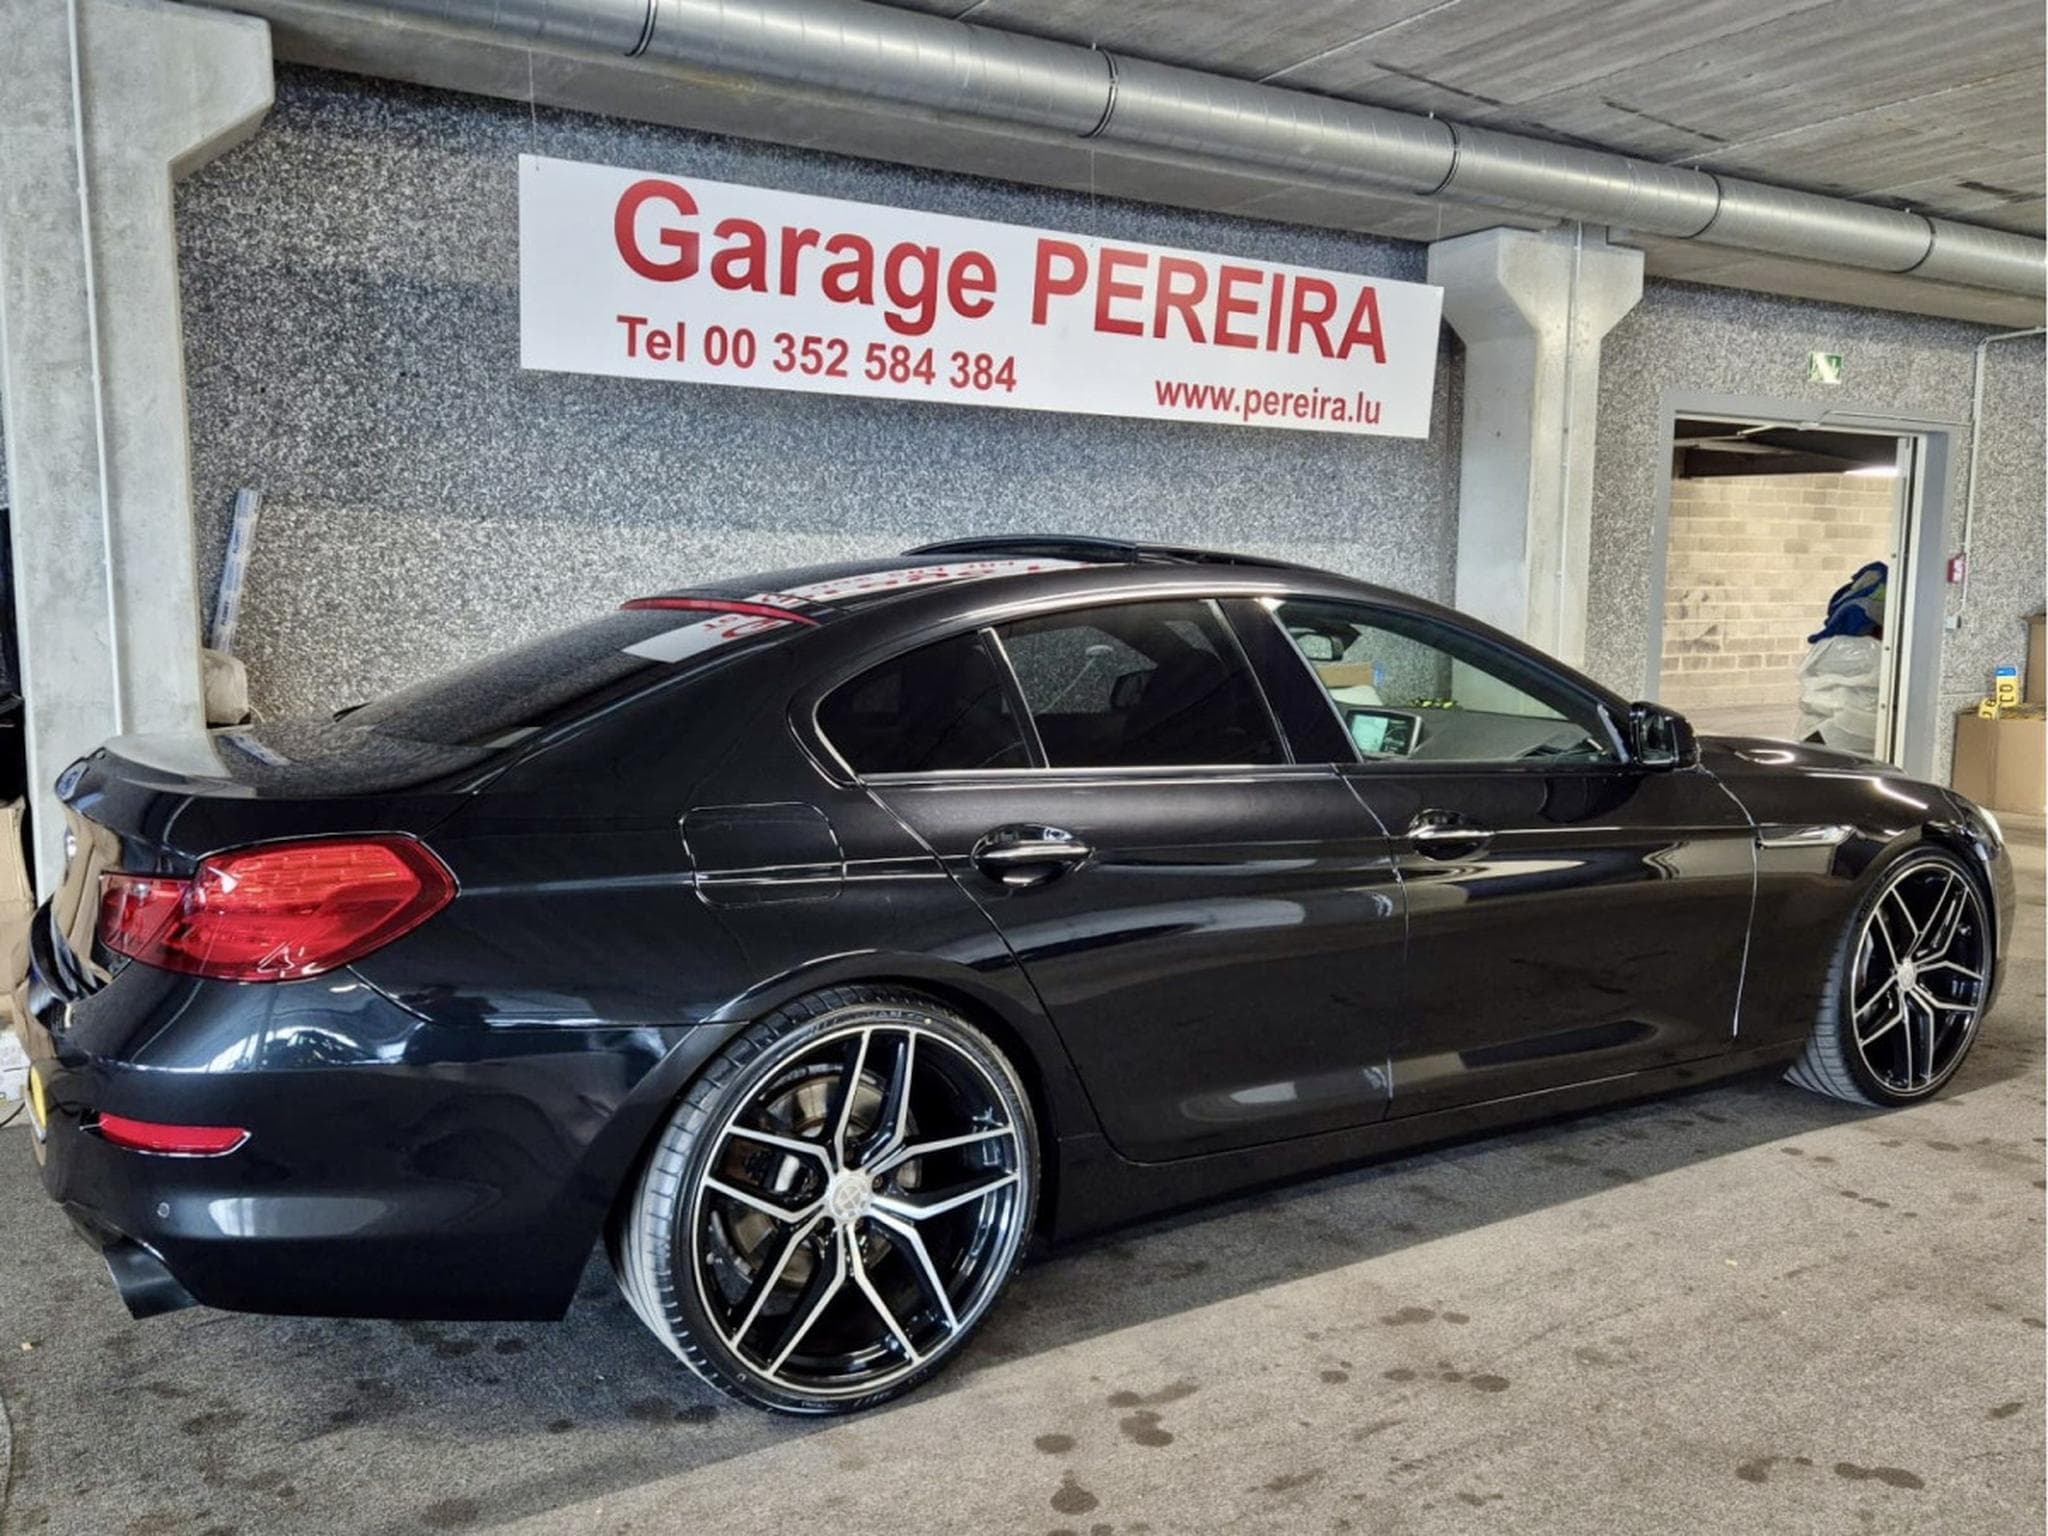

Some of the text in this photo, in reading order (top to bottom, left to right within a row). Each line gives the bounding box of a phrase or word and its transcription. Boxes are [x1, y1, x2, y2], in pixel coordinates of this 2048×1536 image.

[614, 179, 1387, 364] Garage PEREIRA
[617, 315, 1017, 392] Tel 00 352 584 384
[1155, 380, 1381, 424] www.pereira.lu
